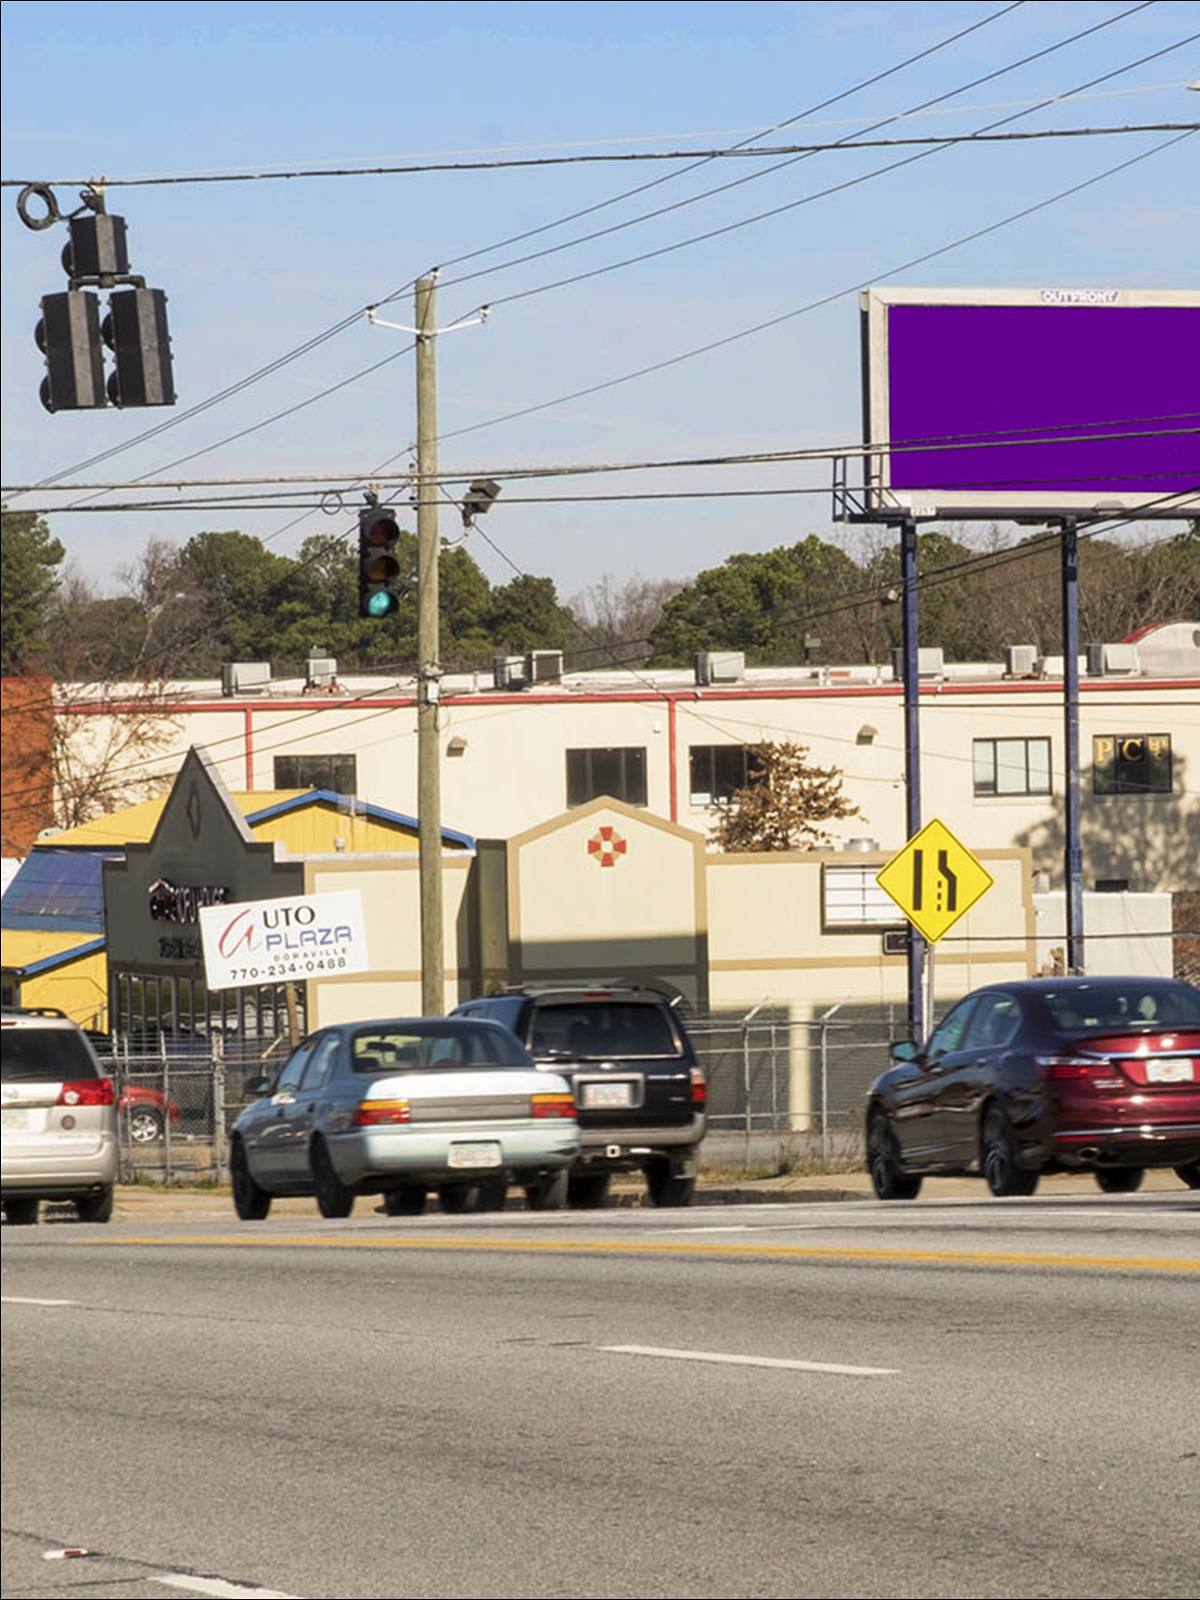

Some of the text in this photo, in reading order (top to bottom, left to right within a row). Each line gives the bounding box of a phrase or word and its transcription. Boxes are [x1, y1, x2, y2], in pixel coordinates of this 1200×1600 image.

[1041, 289, 1118, 304] OUTFRONT
[265, 925, 354, 951] PLAZA
[273, 946, 348, 963] DORAVILLE
[229, 956, 347, 980] 770-234-0488
